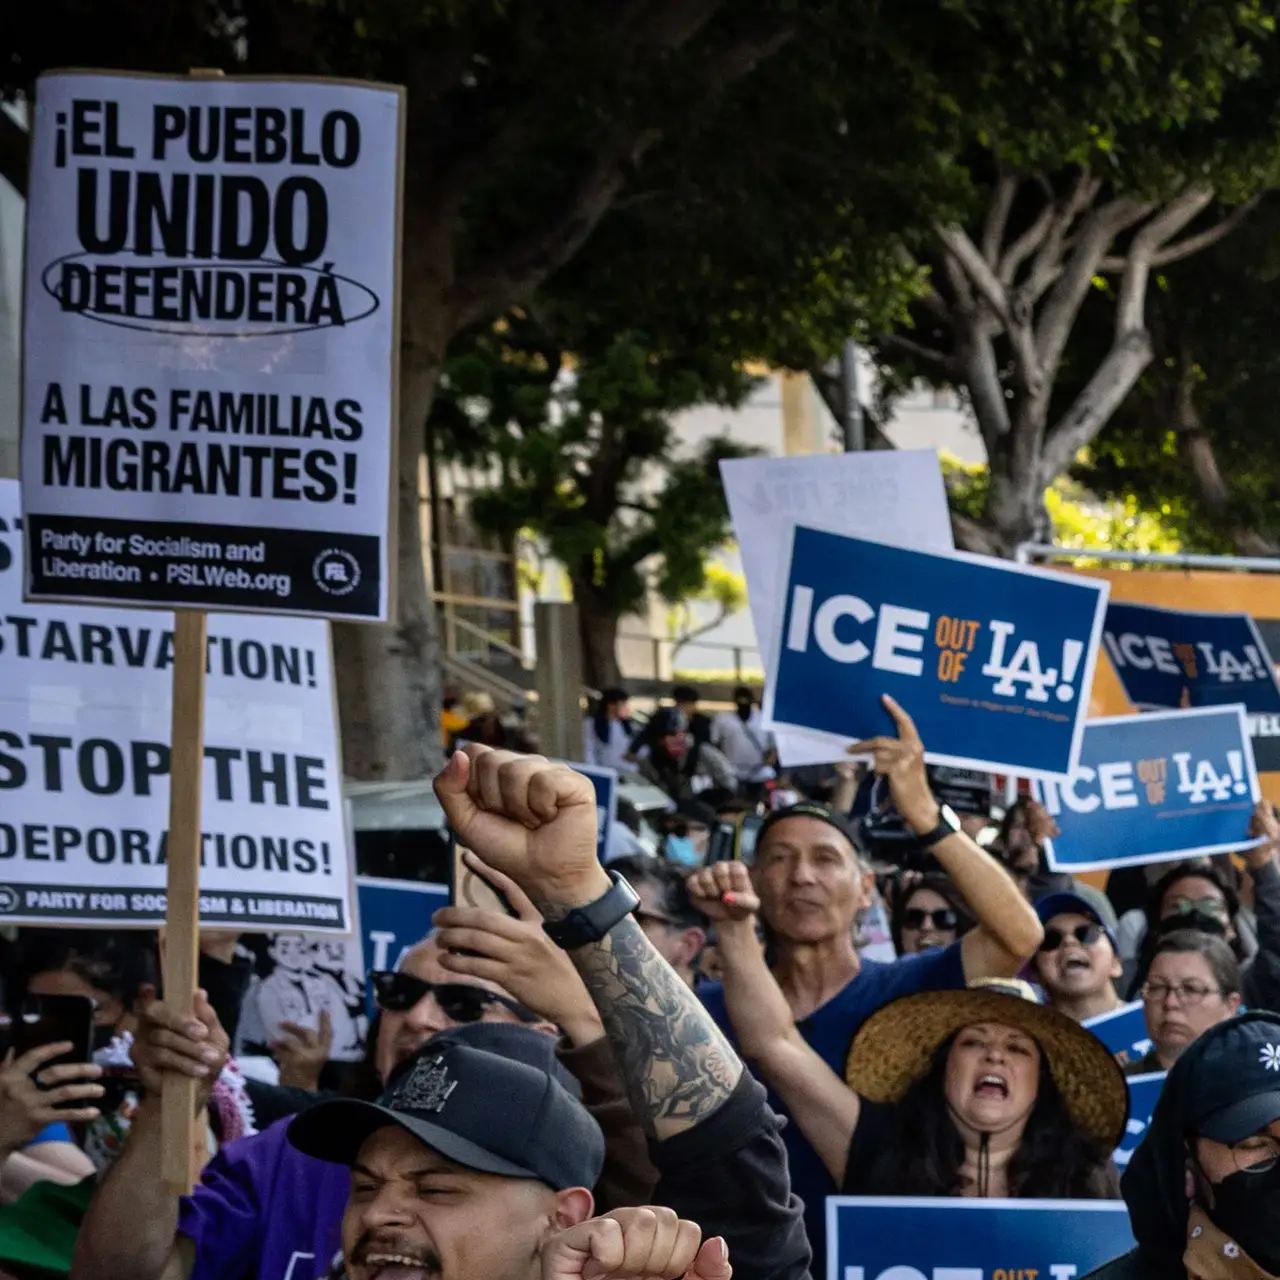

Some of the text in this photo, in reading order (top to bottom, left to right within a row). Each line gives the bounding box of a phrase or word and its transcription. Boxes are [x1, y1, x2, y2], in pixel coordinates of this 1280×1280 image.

[55, 99, 361, 169] ¡EL PUEBLO
[77, 167, 329, 265] UNIDO
[60, 262, 346, 326] DEFENDERÁ
[40, 382, 363, 442] A LAS FAMILIAS
[42, 434, 358, 506] MIGRANTES!
[41, 529, 91, 557] Party
[95, 531, 125, 554] for
[129, 534, 221, 560] Socialism
[226, 541, 265, 563] and
[42, 557, 141, 583] Liberation
[166, 562, 292, 597] PSLWeb.org
[0, 615, 317, 688] TARVAION!
[787, 584, 1085, 704] ICE OUT OF LA!
[1105, 630, 1183, 676] ICE
[1196, 640, 1267, 684] LA!
[0, 730, 330, 811] STOP THE
[1172, 750, 1248, 804] LA!
[26, 890, 86, 910] PARTY
[90, 892, 127, 911] FOR
[249, 899, 339, 919] LIBERATION
